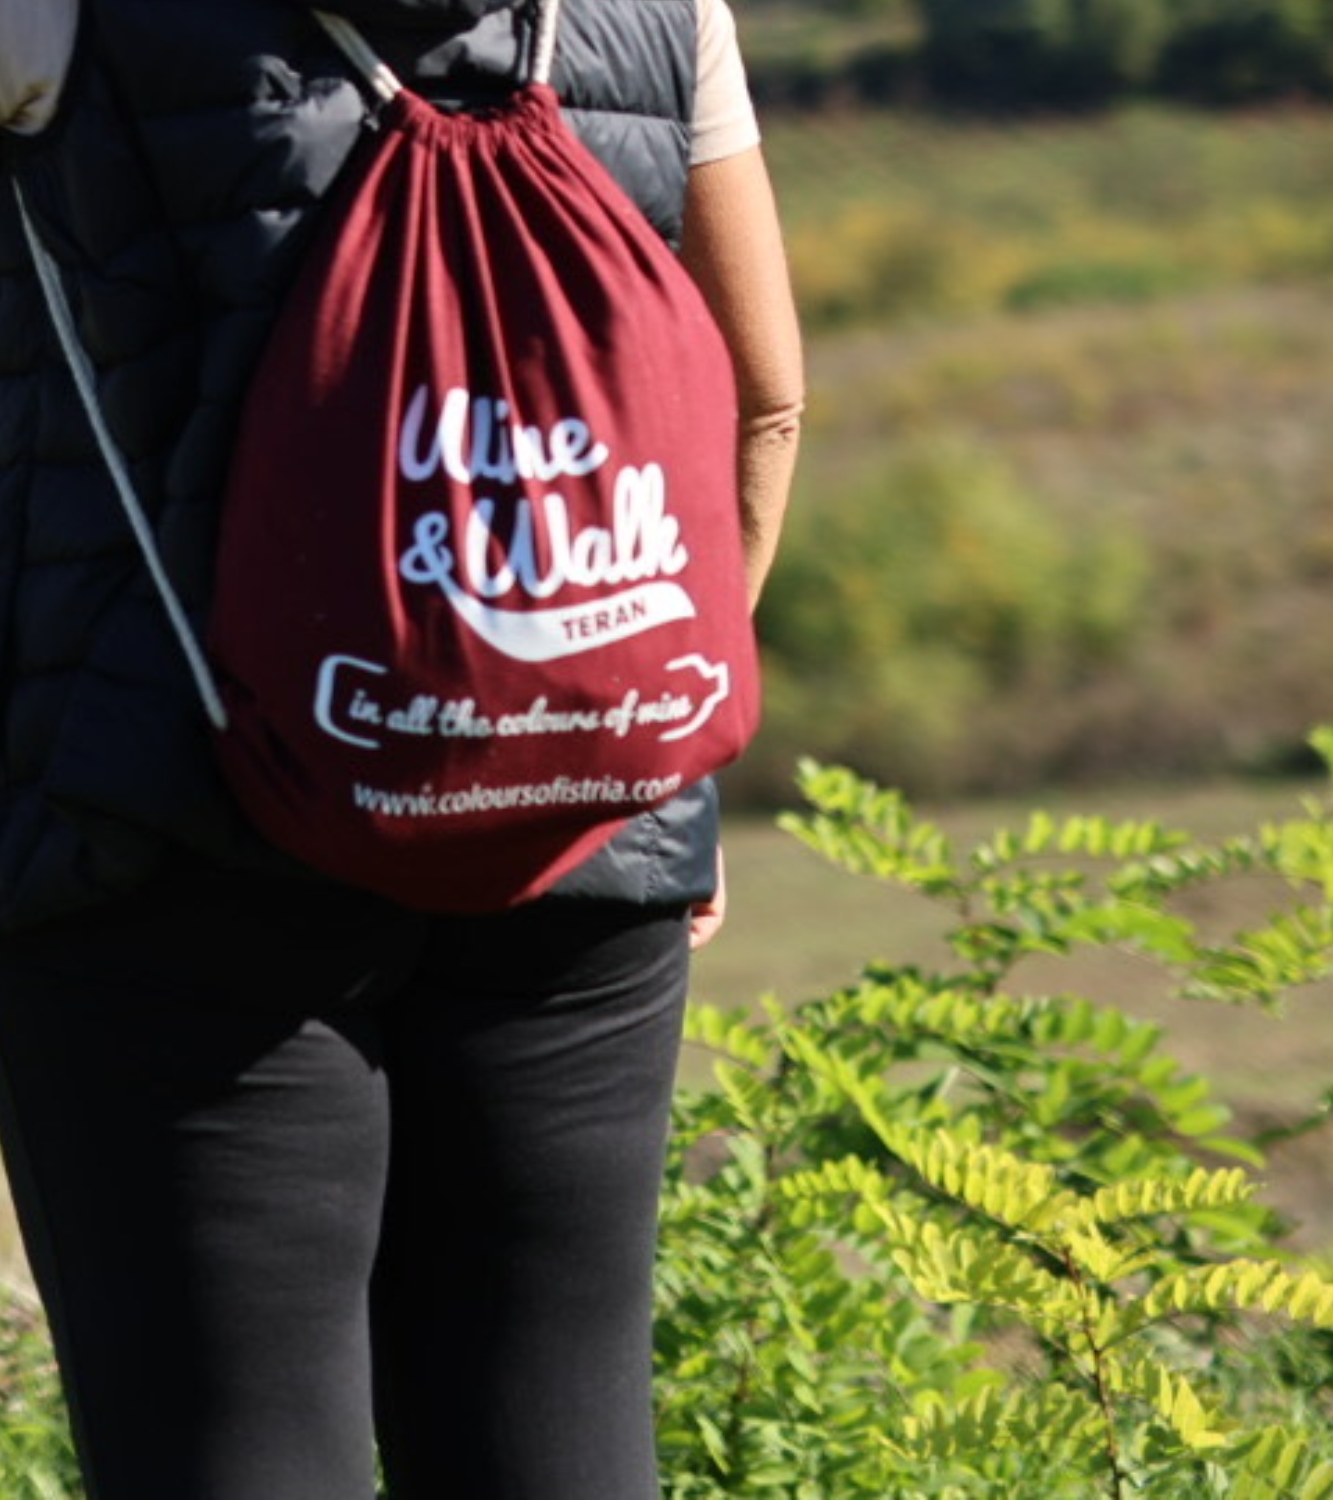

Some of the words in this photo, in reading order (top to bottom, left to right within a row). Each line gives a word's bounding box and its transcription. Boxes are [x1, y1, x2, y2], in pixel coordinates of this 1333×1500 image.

[399, 384, 609, 484] Wine
[399, 511, 454, 584] &
[465, 462, 689, 599] Walk
[562, 597, 648, 642] TERAN
[348, 690, 381, 725] in
[386, 694, 437, 736] all
[439, 698, 495, 738] the
[496, 696, 602, 737] colours
[603, 689, 638, 738] of
